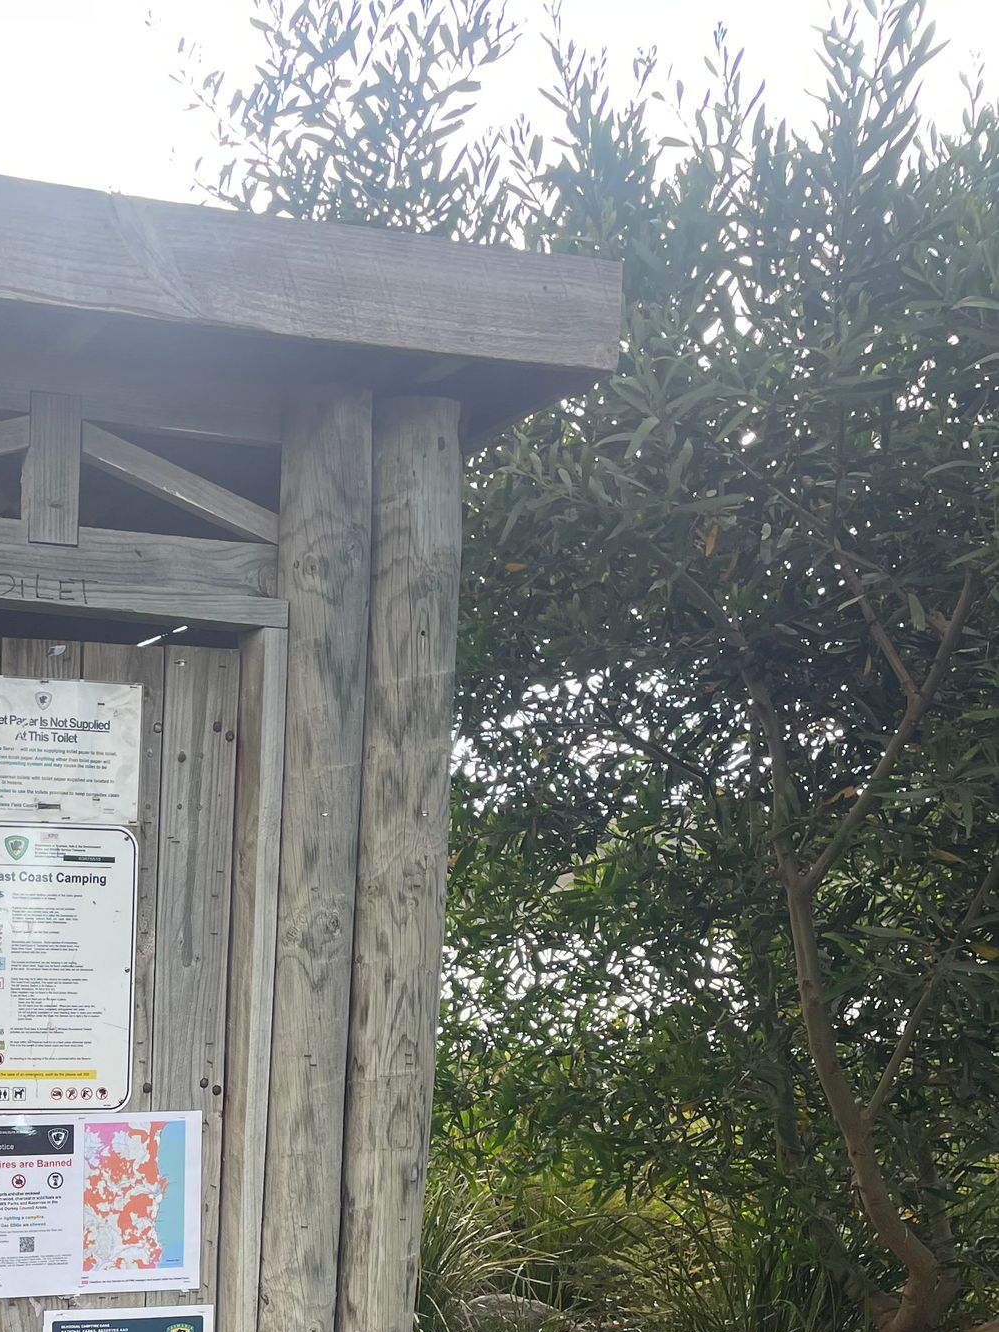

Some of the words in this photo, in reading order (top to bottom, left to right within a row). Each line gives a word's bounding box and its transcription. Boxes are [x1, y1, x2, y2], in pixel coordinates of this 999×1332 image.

[40, 716, 48, 727] Is
[50, 717, 68, 728] Not
[69, 717, 110, 731] Supplied
[15, 732, 27, 741] At
[28, 731, 50, 742] This
[52, 732, 77, 744] Toilet
[19, 872, 53, 883] Coast
[56, 873, 107, 886] Camping
[19, 1161, 35, 1170] are
[37, 1159, 72, 1169] Banned
